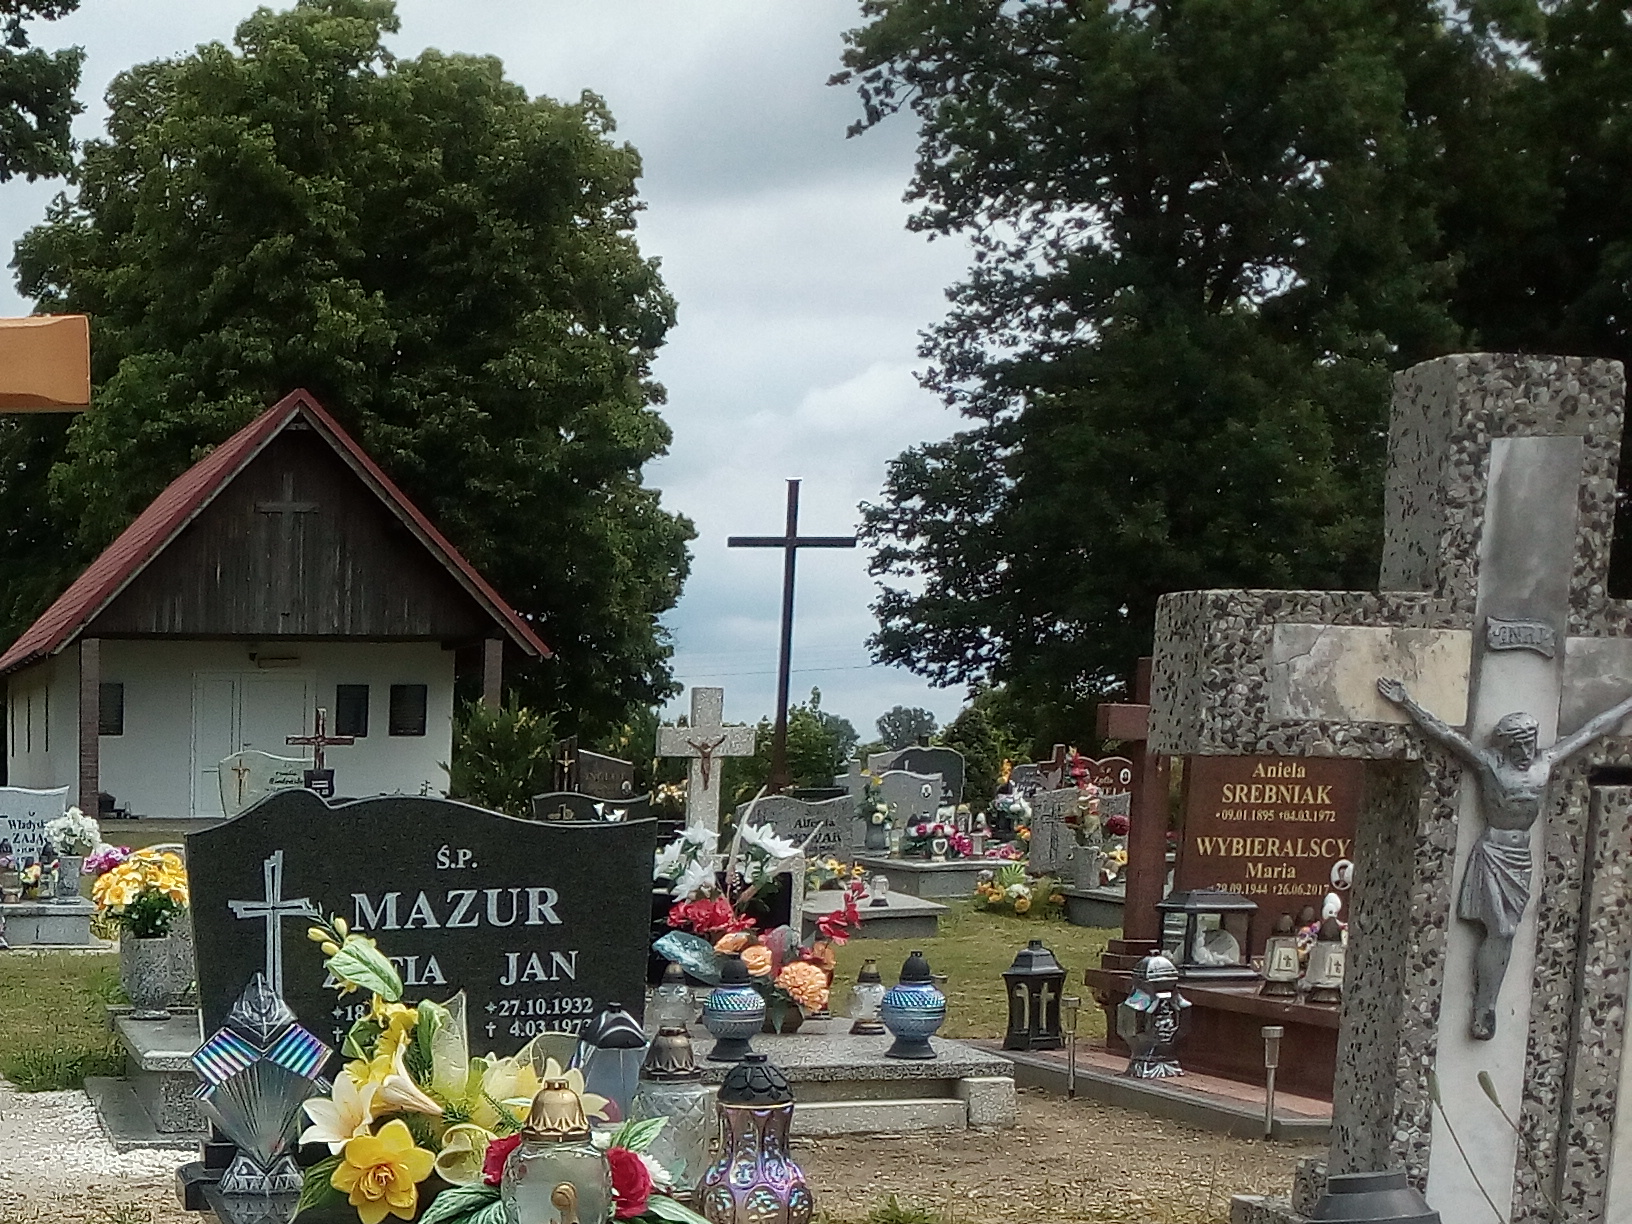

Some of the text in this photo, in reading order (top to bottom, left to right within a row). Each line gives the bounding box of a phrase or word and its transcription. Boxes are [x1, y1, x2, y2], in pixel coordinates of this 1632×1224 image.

[1251, 762, 1306, 779] Aniela
[1221, 783, 1332, 806] SREBNIAK
[436, 844, 479, 870] Ś.P.
[1196, 837, 1352, 858] WYBIERALSCY
[1245, 862, 1297, 880] Maria
[350, 886, 563, 932] MAZUR
[499, 950, 580, 987] JAN
[498, 997, 594, 1017] 27.10.1932
